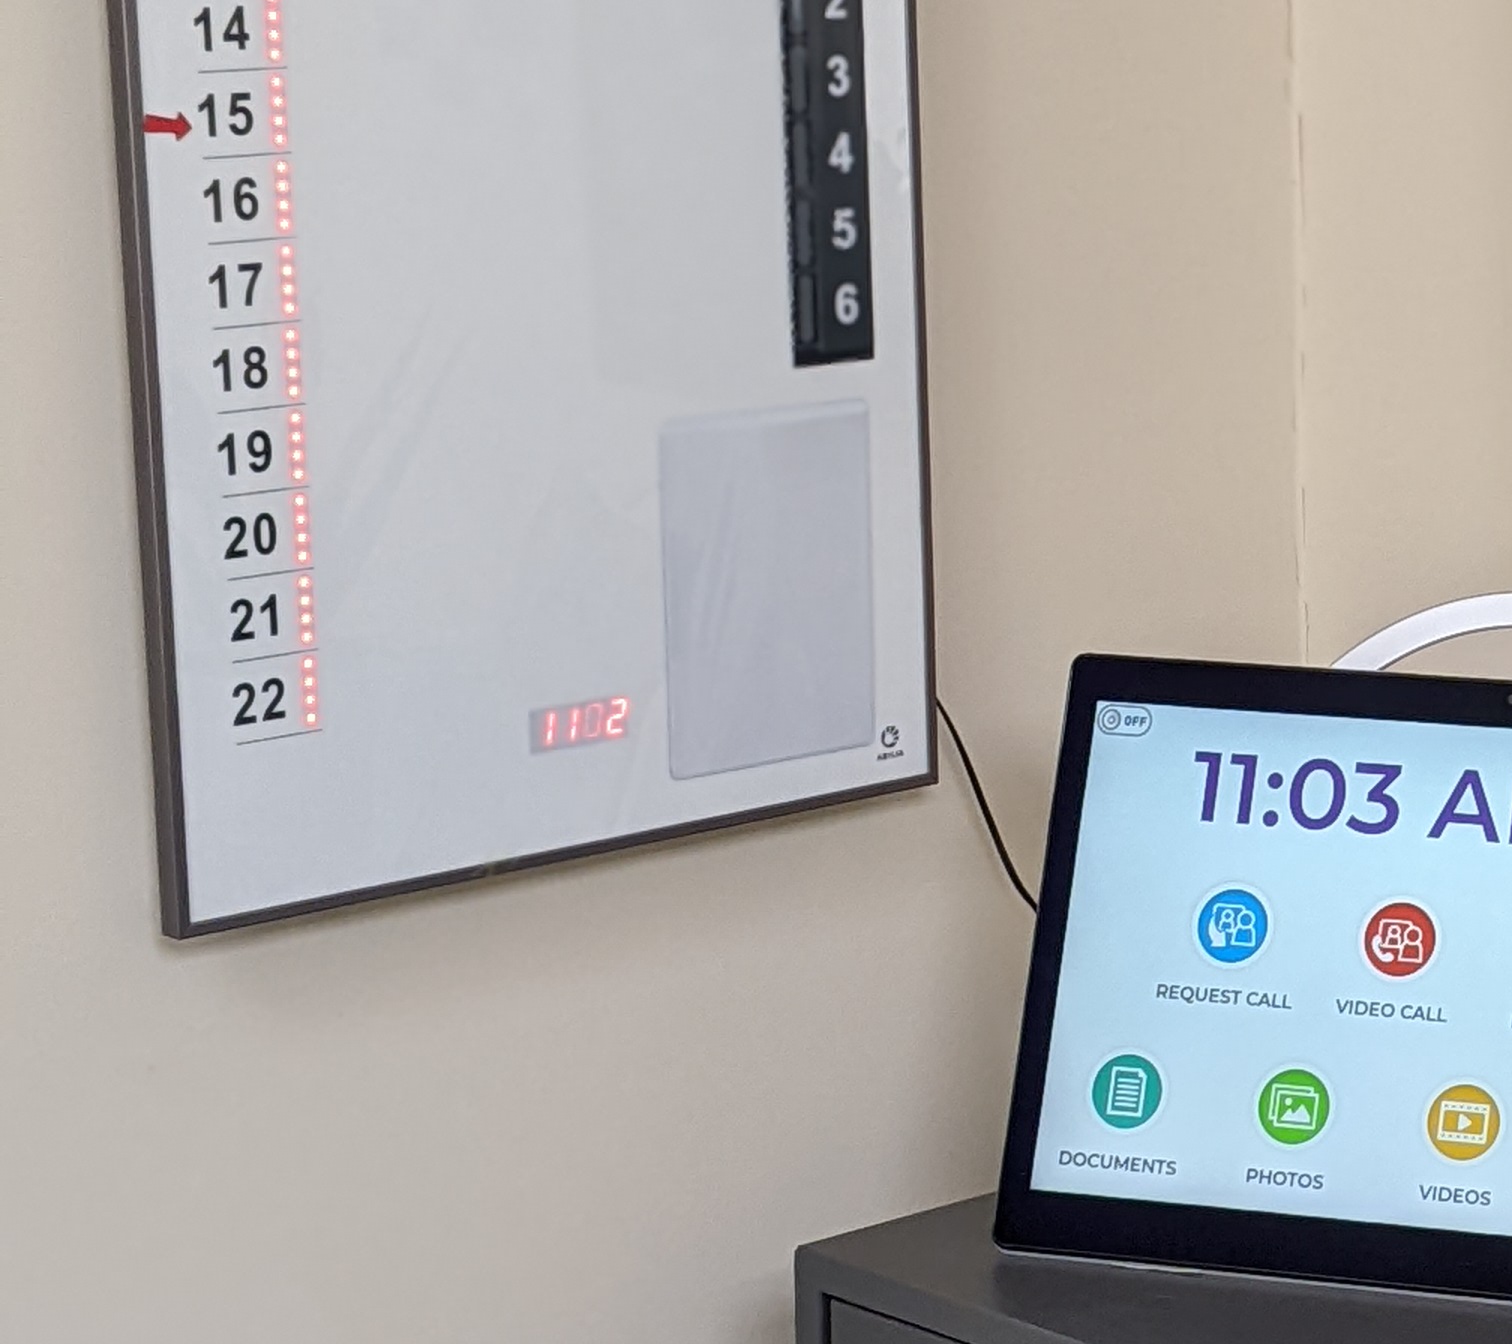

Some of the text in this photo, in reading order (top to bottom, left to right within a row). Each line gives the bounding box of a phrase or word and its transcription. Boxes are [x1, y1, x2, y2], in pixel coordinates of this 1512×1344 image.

[193, 5, 250, 52] 14
[826, 54, 851, 97] 3
[197, 92, 254, 138] 15
[827, 130, 854, 175] 4
[203, 176, 260, 223] 16
[831, 207, 858, 250] 5
[208, 262, 263, 309] 17
[834, 281, 860, 325] 6
[212, 345, 268, 392] 18
[217, 429, 272, 476] 19
[222, 512, 277, 560] 20
[230, 593, 279, 642] 21
[232, 677, 286, 727] 22
[1124, 715, 1148, 728] OFF
[1195, 750, 1403, 835] 11:03
[1156, 982, 1293, 1010] REQUEST CALL
[1335, 998, 1448, 1023] VIDEO CALL
[1058, 1150, 1177, 1175] DOCUMENTS
[1245, 1168, 1325, 1190] PHOTOS
[1418, 1184, 1492, 1206] VIDEOS
